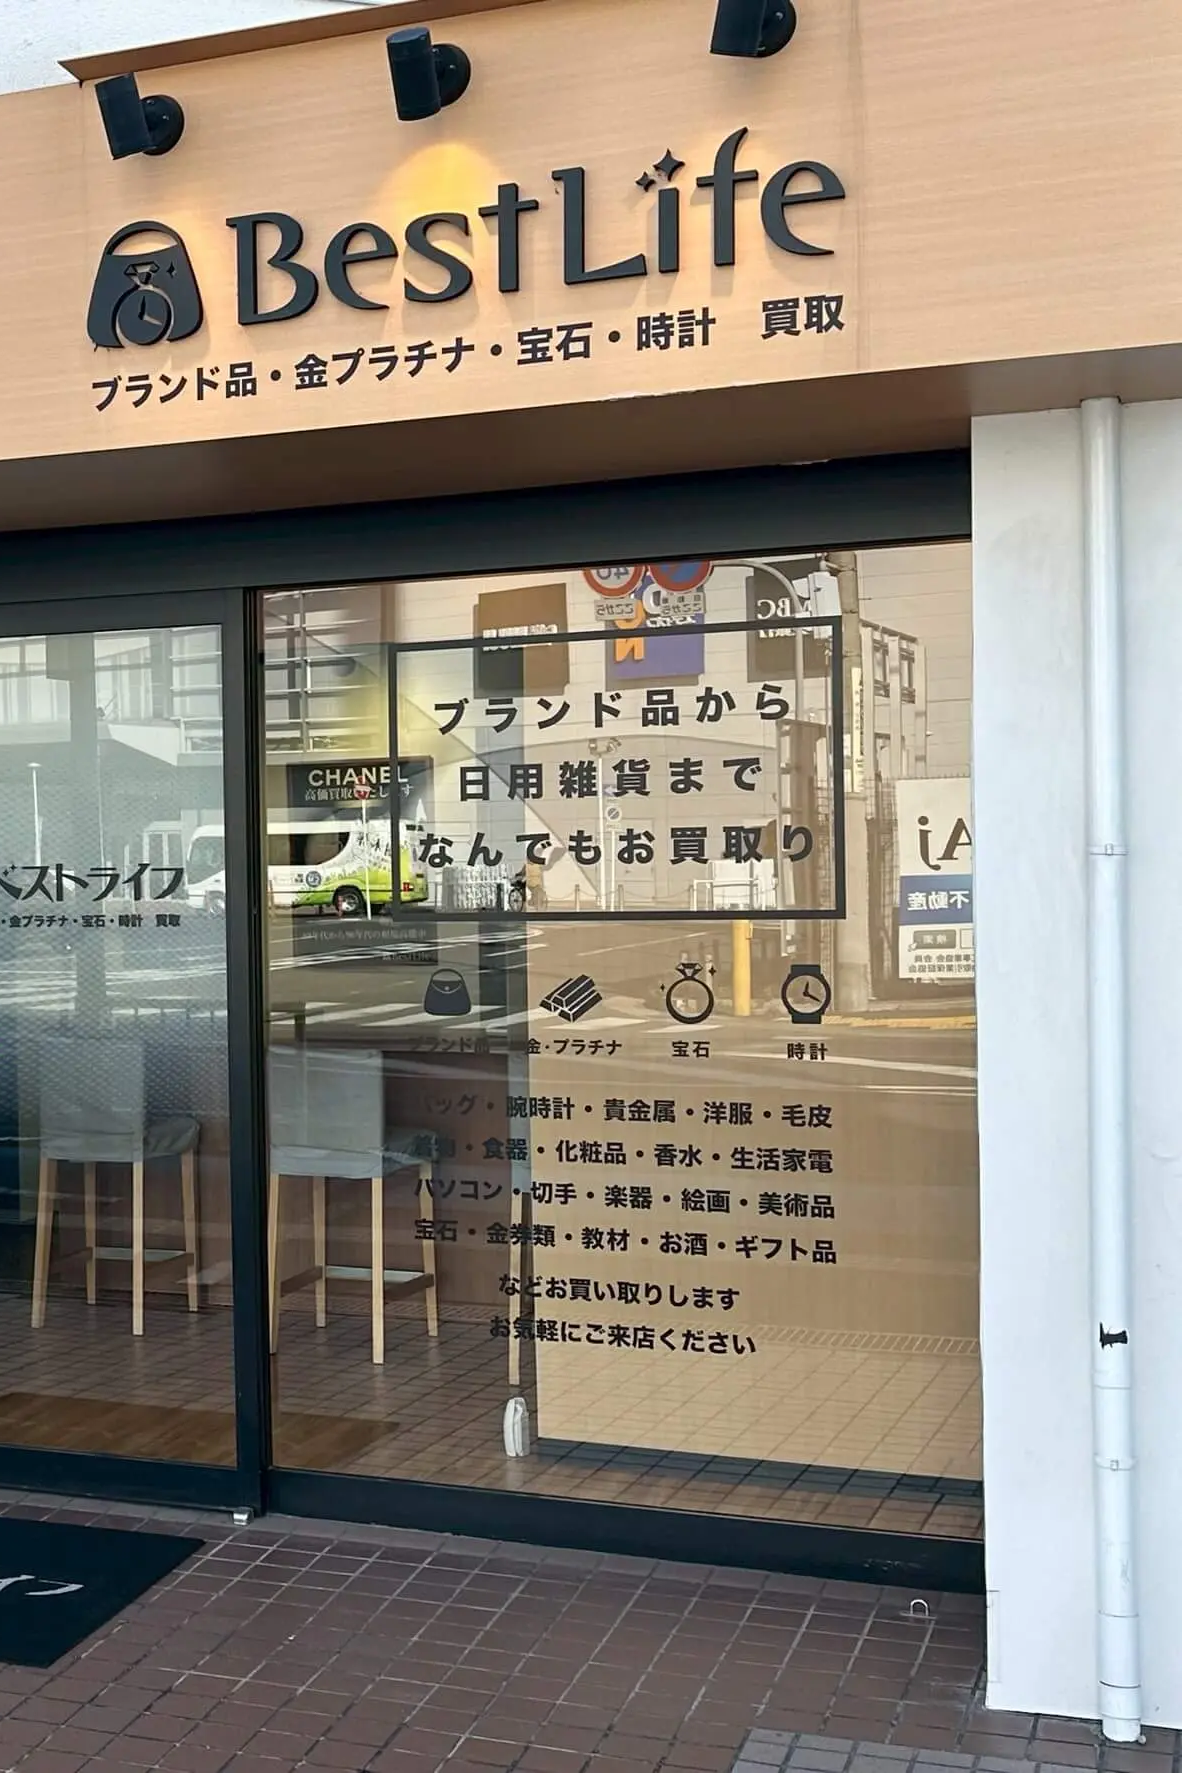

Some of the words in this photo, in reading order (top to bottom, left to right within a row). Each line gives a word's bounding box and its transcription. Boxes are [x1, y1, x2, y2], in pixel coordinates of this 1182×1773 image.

[226, 127, 846, 326] BestLife
[92, 307, 717, 412] ブランド品・金プラチナ・宝石・時計
[761, 294, 845, 341] 買取
[434, 683, 790, 735] ブランド品から
[308, 766, 408, 787] CHANEL
[459, 757, 762, 802] 日用雑貨まで
[419, 825, 814, 868] なんでもお買取り
[155, 914, 181, 928] 買取
[526, 1038, 623, 1056] 金・プラチナ
[671, 1040, 711, 1058] 宝石
[786, 1043, 828, 1061] 時計
[499, 1273, 740, 1311] などお買い取りします
[490, 1316, 756, 1355] お気軽にご来店ください
